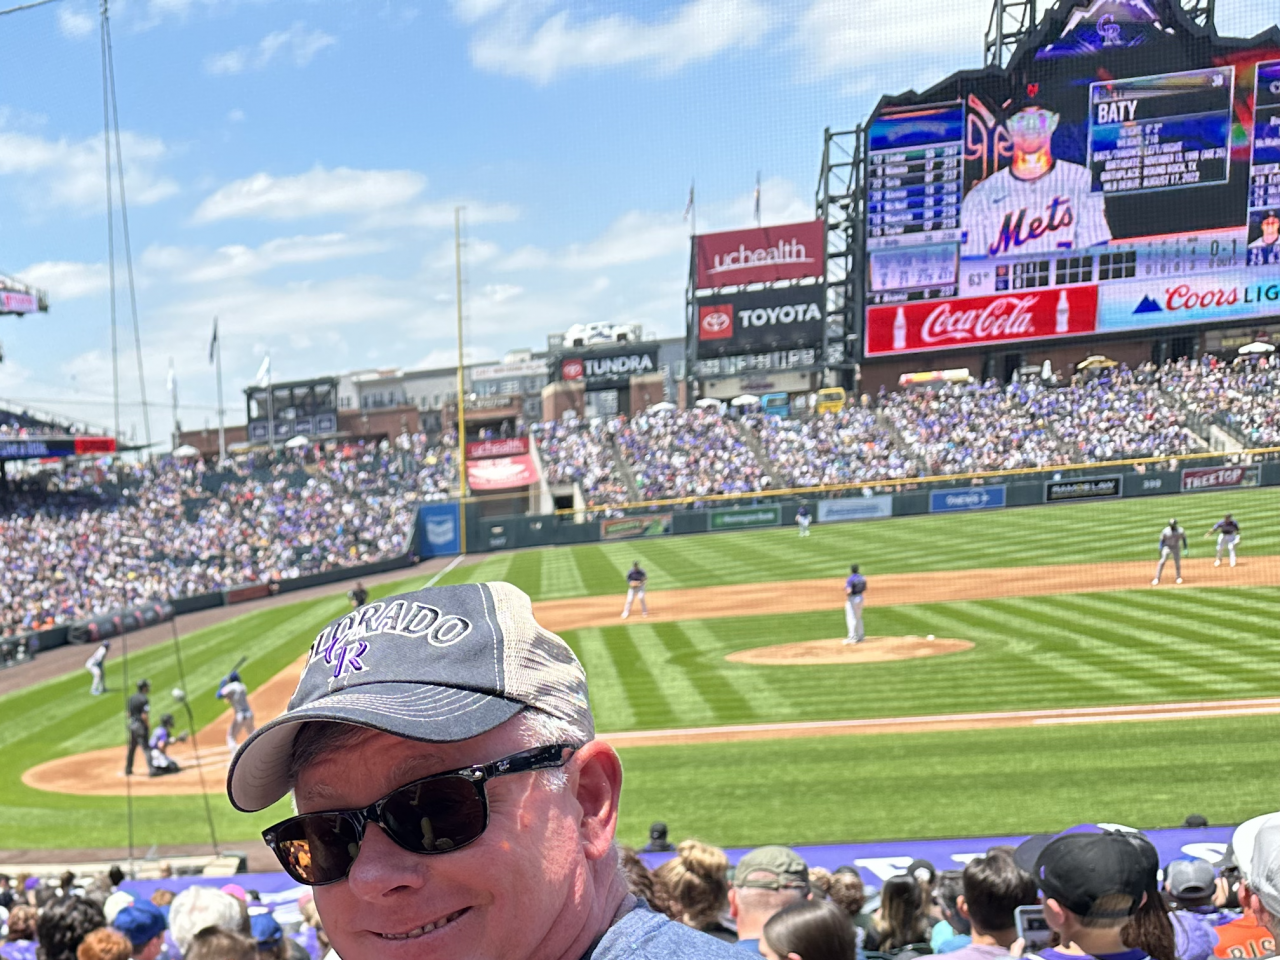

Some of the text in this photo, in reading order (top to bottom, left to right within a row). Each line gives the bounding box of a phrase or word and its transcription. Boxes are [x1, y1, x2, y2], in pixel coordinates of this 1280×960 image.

[1098, 100, 1139, 124] BATY
[988, 196, 1074, 256] Mets
[713, 238, 806, 270] uchealth
[1165, 284, 1240, 311] Coors
[738, 303, 821, 328] TOYOTA
[921, 295, 1039, 343] Coca-Cola
[584, 354, 653, 375] TUNDRA
[306, 600, 472, 666] LORADO
